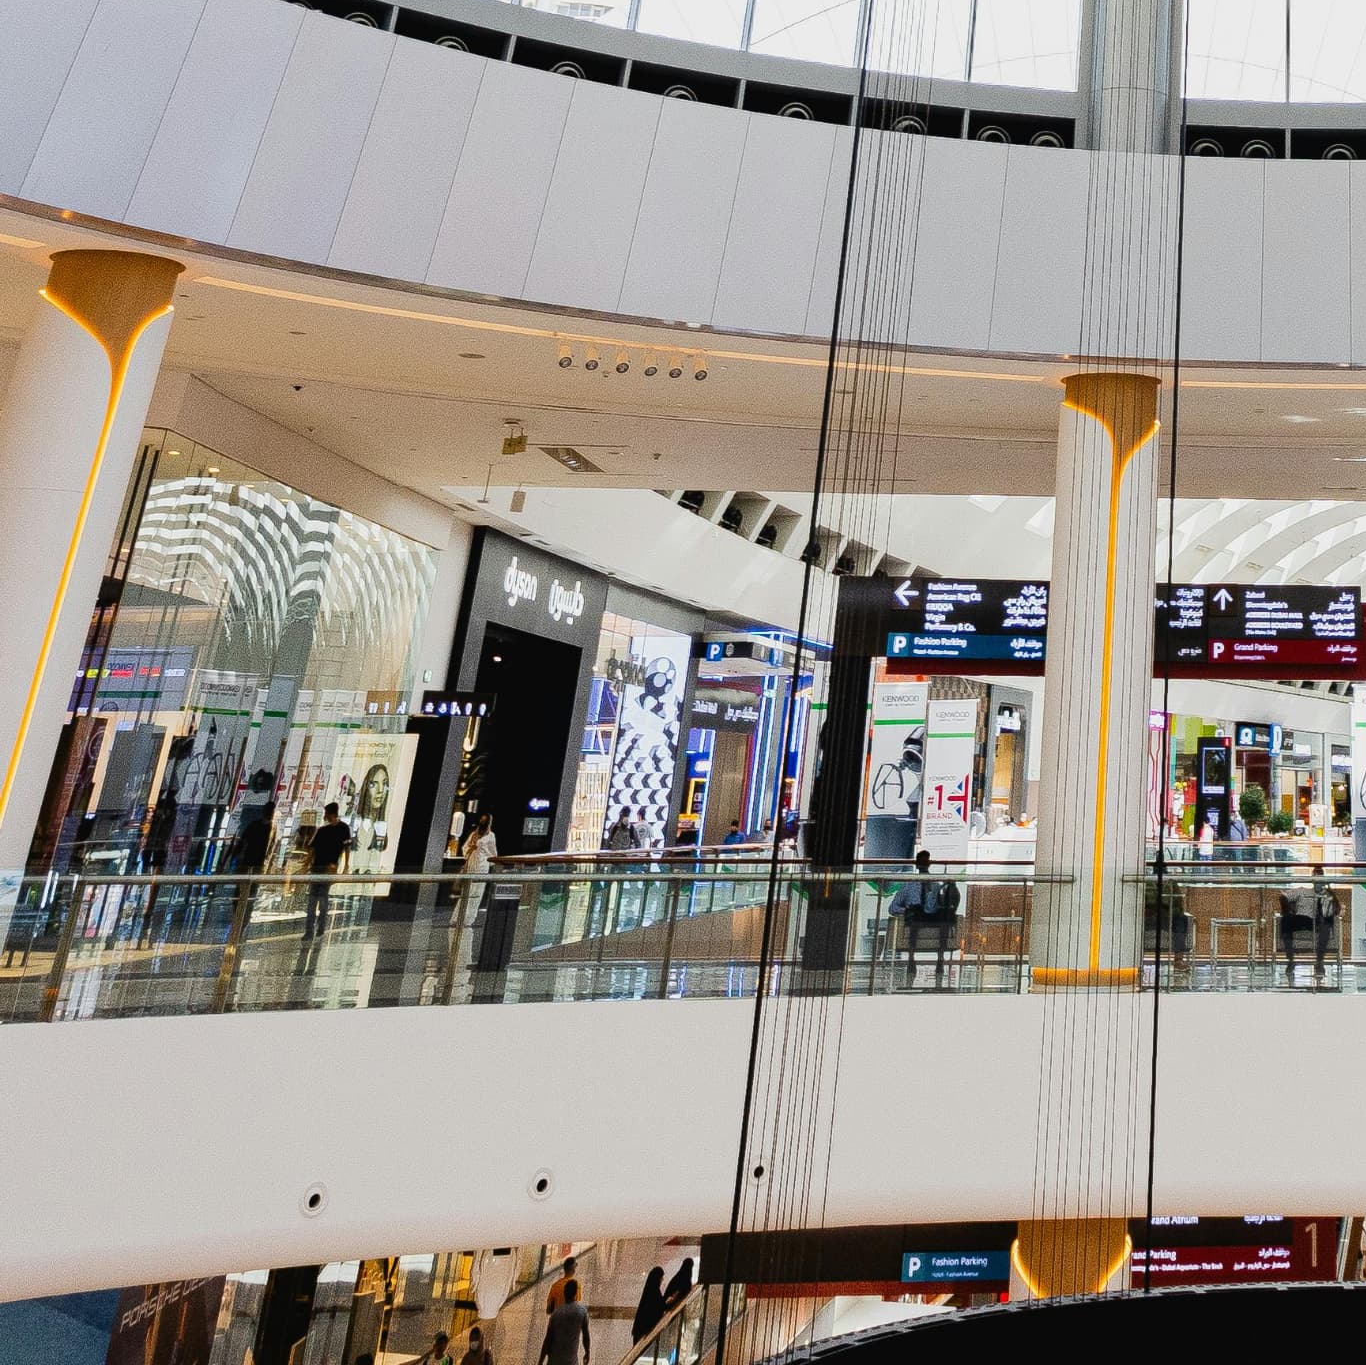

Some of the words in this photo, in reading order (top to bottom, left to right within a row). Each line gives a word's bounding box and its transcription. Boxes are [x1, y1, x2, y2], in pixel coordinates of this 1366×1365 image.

[504, 556, 538, 607] dyson
[893, 635, 907, 653] P
[914, 637, 940, 645] Fashion
[941, 637, 967, 648] Parking
[1213, 642, 1225, 659] P
[1234, 643, 1254, 651] Grand
[1254, 643, 1278, 653] Parking
[710, 644, 721, 659] P
[882, 695, 920, 703] KENWOOD
[928, 784, 943, 810] #1
[1151, 1216, 1170, 1225] rand
[1305, 1222, 1318, 1268] 1
[908, 1257, 922, 1278] P
[932, 1257, 960, 1267] Fashion
[960, 1257, 988, 1268] Parking
[120, 1281, 183, 1333] PORSCHE
